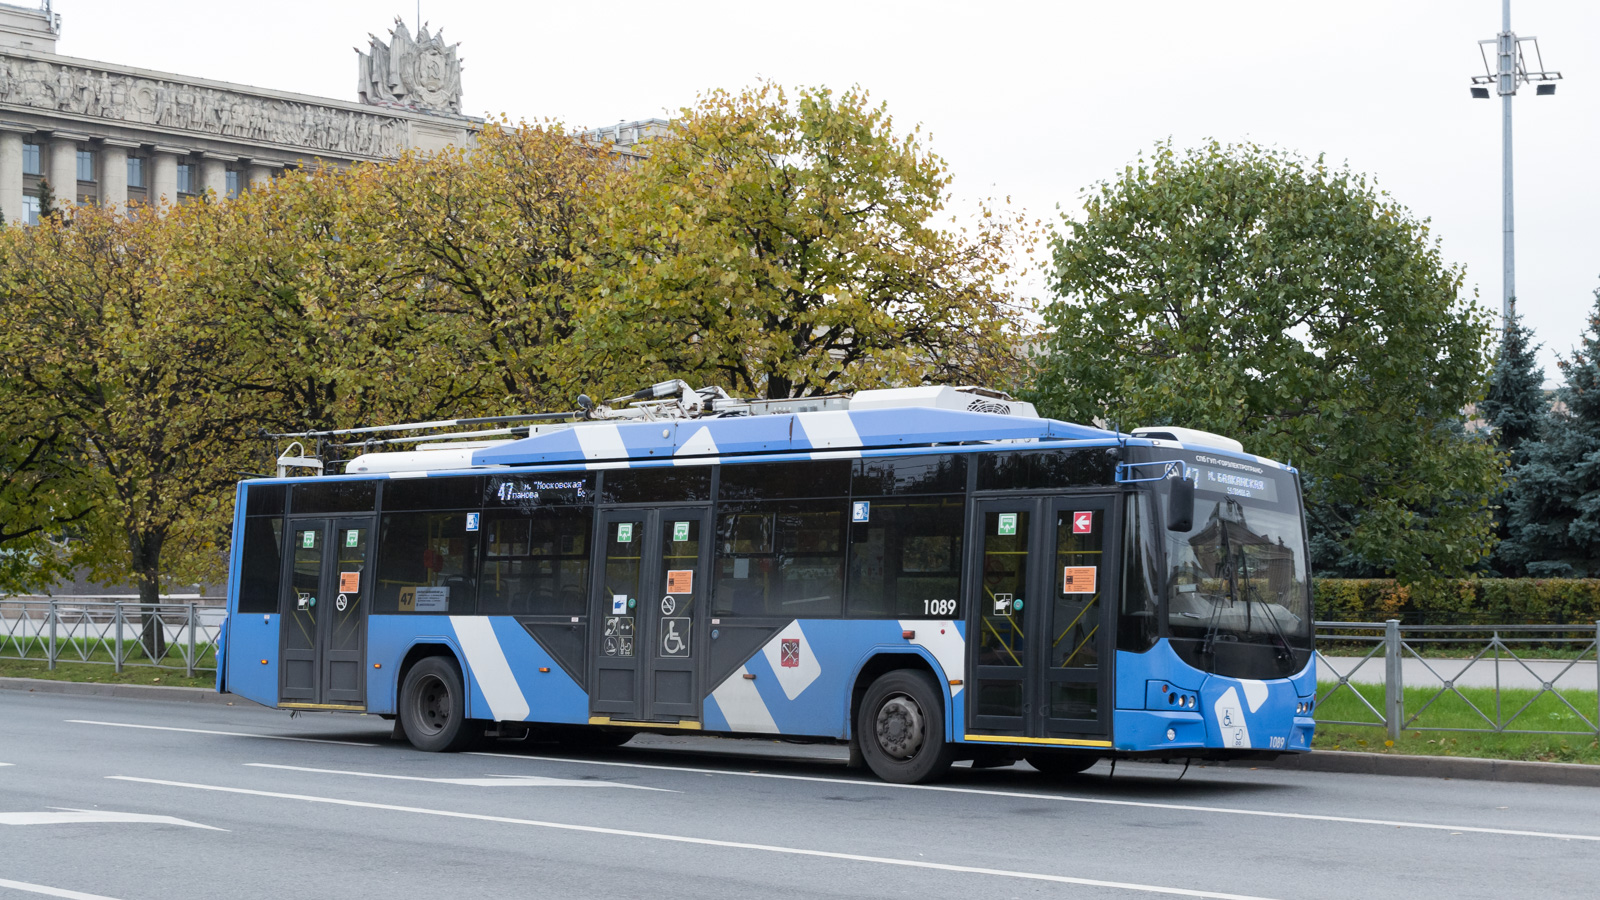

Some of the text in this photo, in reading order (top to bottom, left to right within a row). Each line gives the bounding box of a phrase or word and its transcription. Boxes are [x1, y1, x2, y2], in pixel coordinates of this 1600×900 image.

[533, 479, 587, 490] "Московская"
[497, 482, 514, 501] 47
[512, 491, 539, 499] панова
[400, 593, 414, 605] 47
[924, 599, 957, 615] 1089
[1269, 735, 1285, 749] 1089
